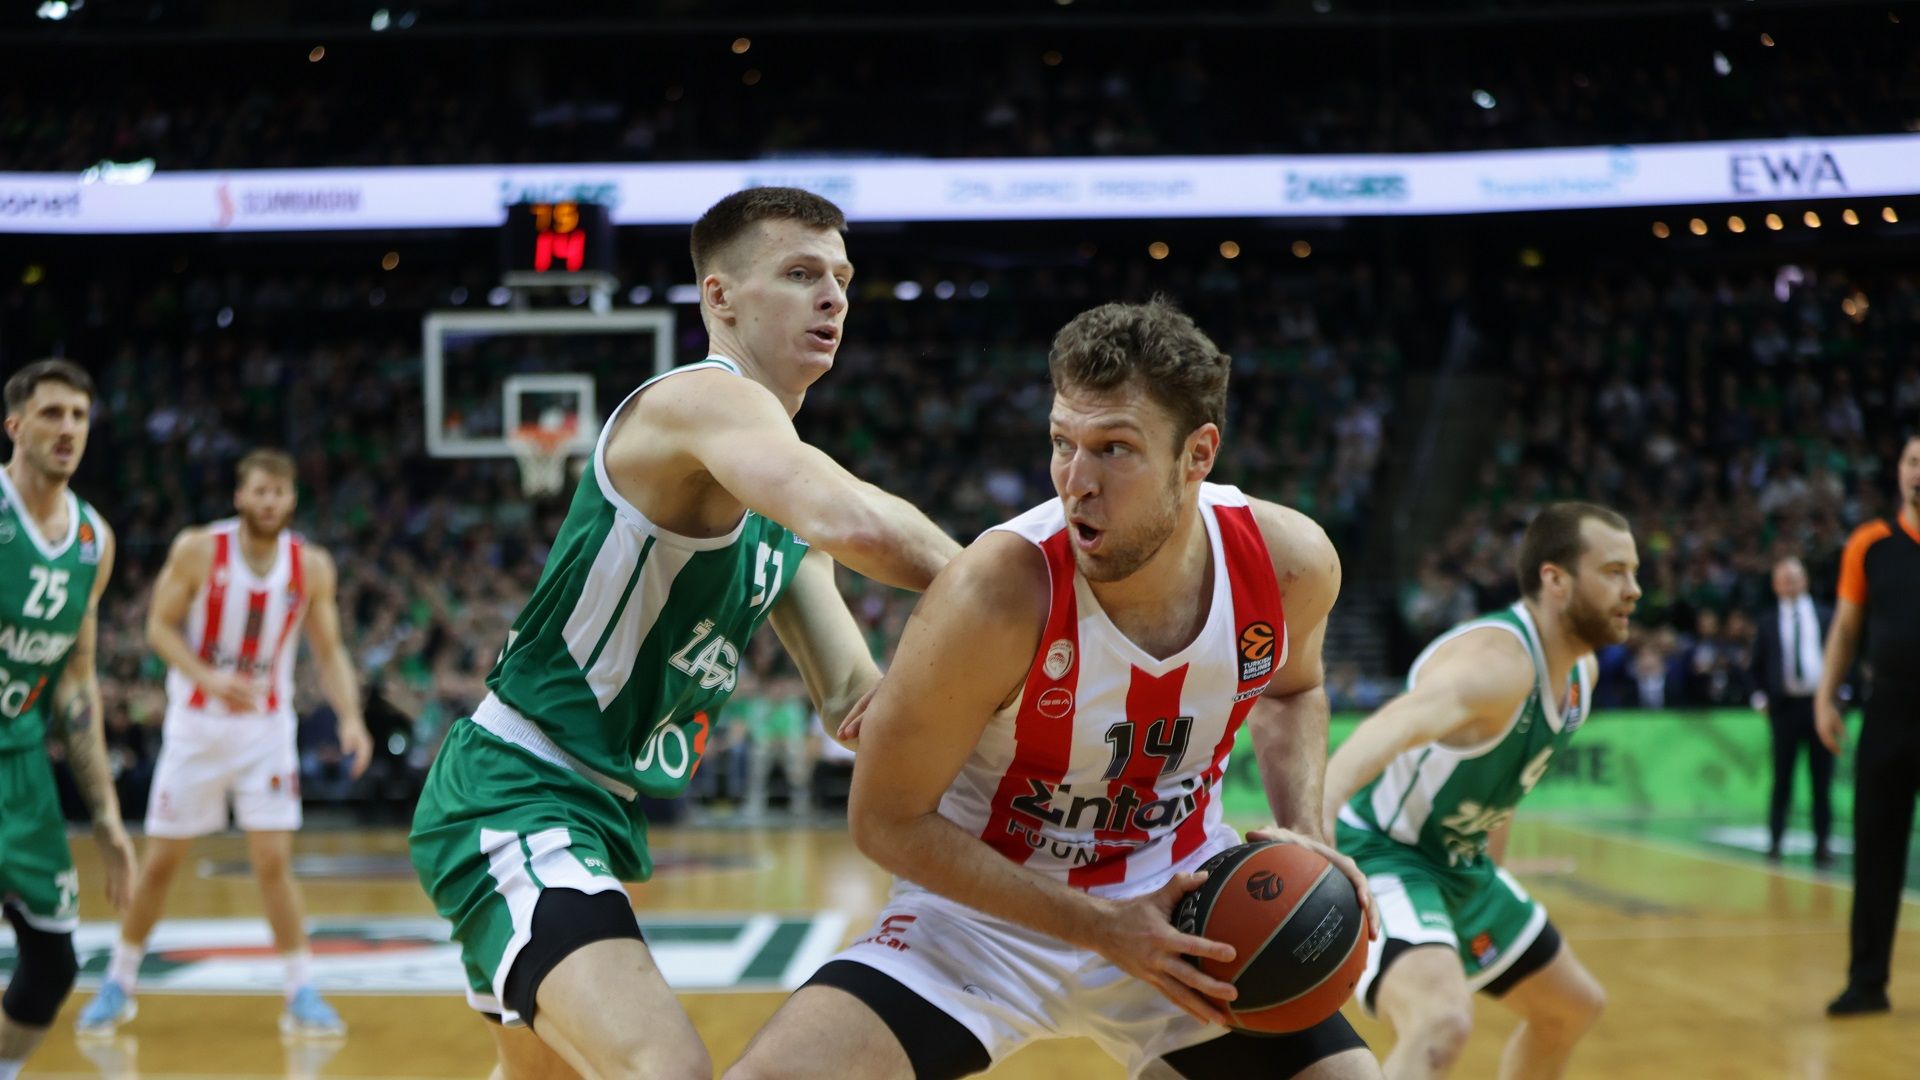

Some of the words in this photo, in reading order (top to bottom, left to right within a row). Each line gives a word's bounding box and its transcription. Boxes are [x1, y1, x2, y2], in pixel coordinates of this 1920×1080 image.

[1730, 152, 1849, 194] EWA
[534, 229, 586, 273] 14
[22, 566, 70, 621] 25
[1101, 716, 1193, 782] 14
